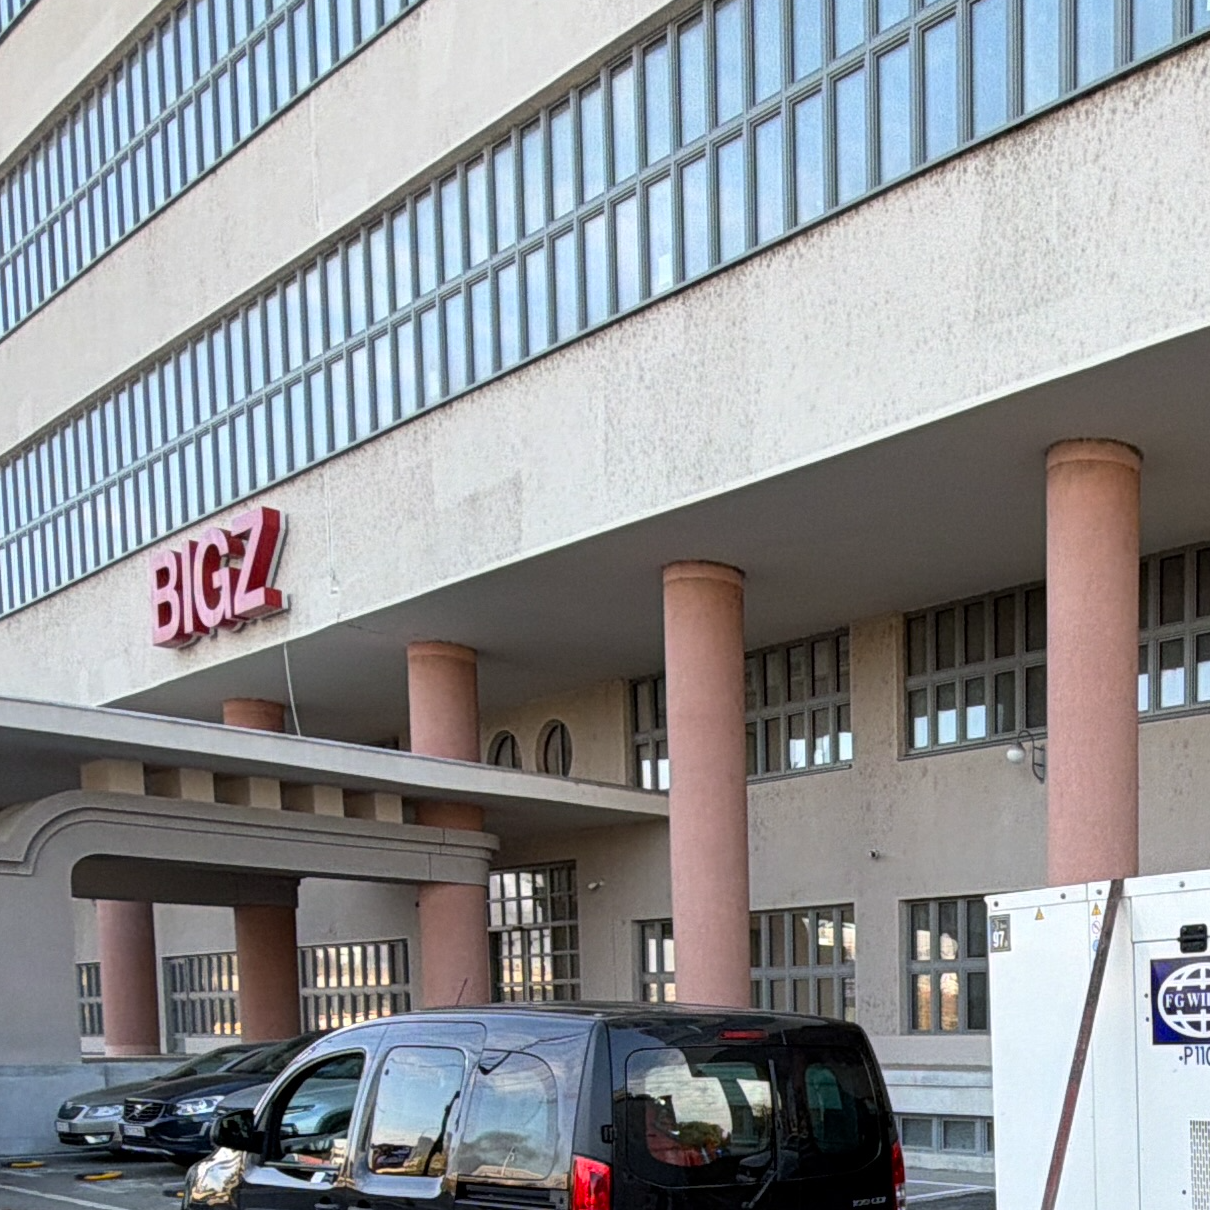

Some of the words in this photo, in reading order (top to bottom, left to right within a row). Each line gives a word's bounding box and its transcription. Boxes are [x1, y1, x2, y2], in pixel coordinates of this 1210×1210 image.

[151, 507, 281, 647] BIGZ
[993, 931, 1005, 948] 97
[1165, 993, 1185, 1009] FG
